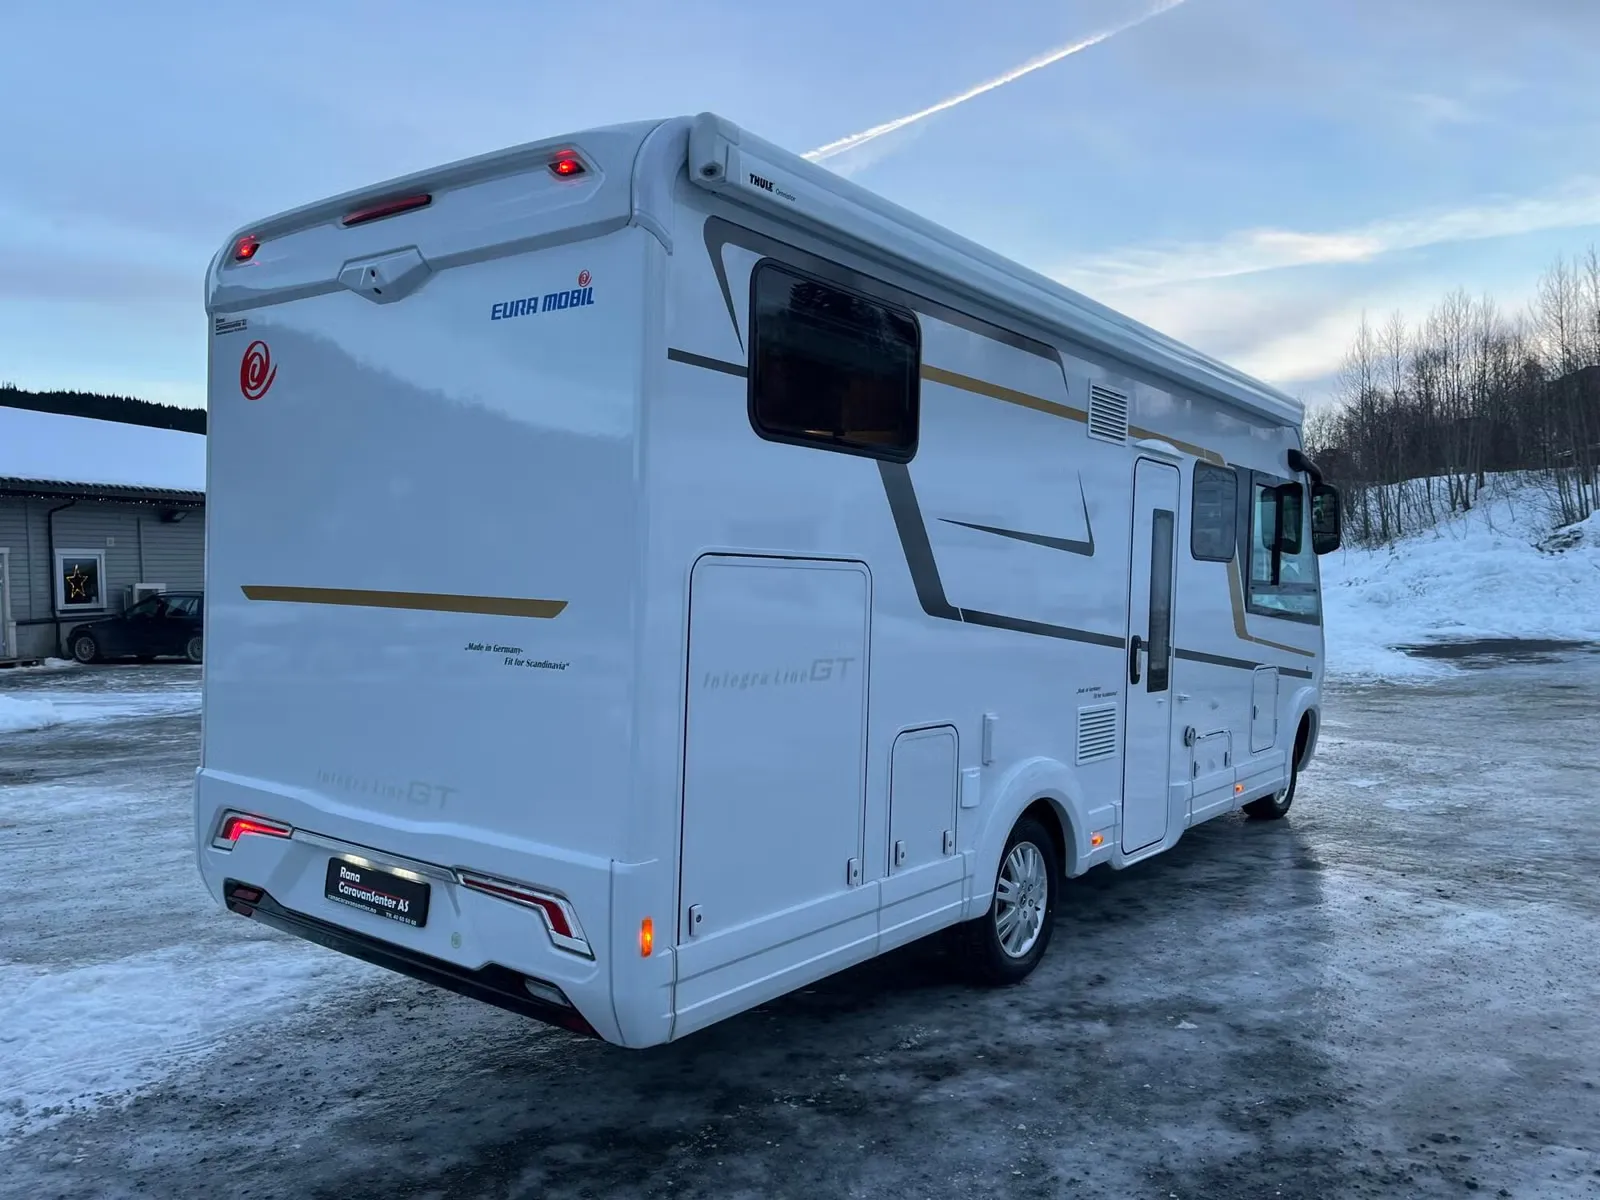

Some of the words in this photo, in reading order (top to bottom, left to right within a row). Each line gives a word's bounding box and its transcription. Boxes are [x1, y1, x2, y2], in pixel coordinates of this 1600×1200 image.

[749, 173, 774, 192] THULE
[491, 297, 539, 320] EURA
[541, 287, 594, 312] MOBIL
[485, 644, 492, 652] in
[504, 657, 513, 666] Fit
[514, 658, 525, 667] for
[809, 657, 855, 684] GT
[340, 866, 360, 883] Rana
[338, 881, 397, 909] CaravanSenter
[397, 899, 409, 913] AS
